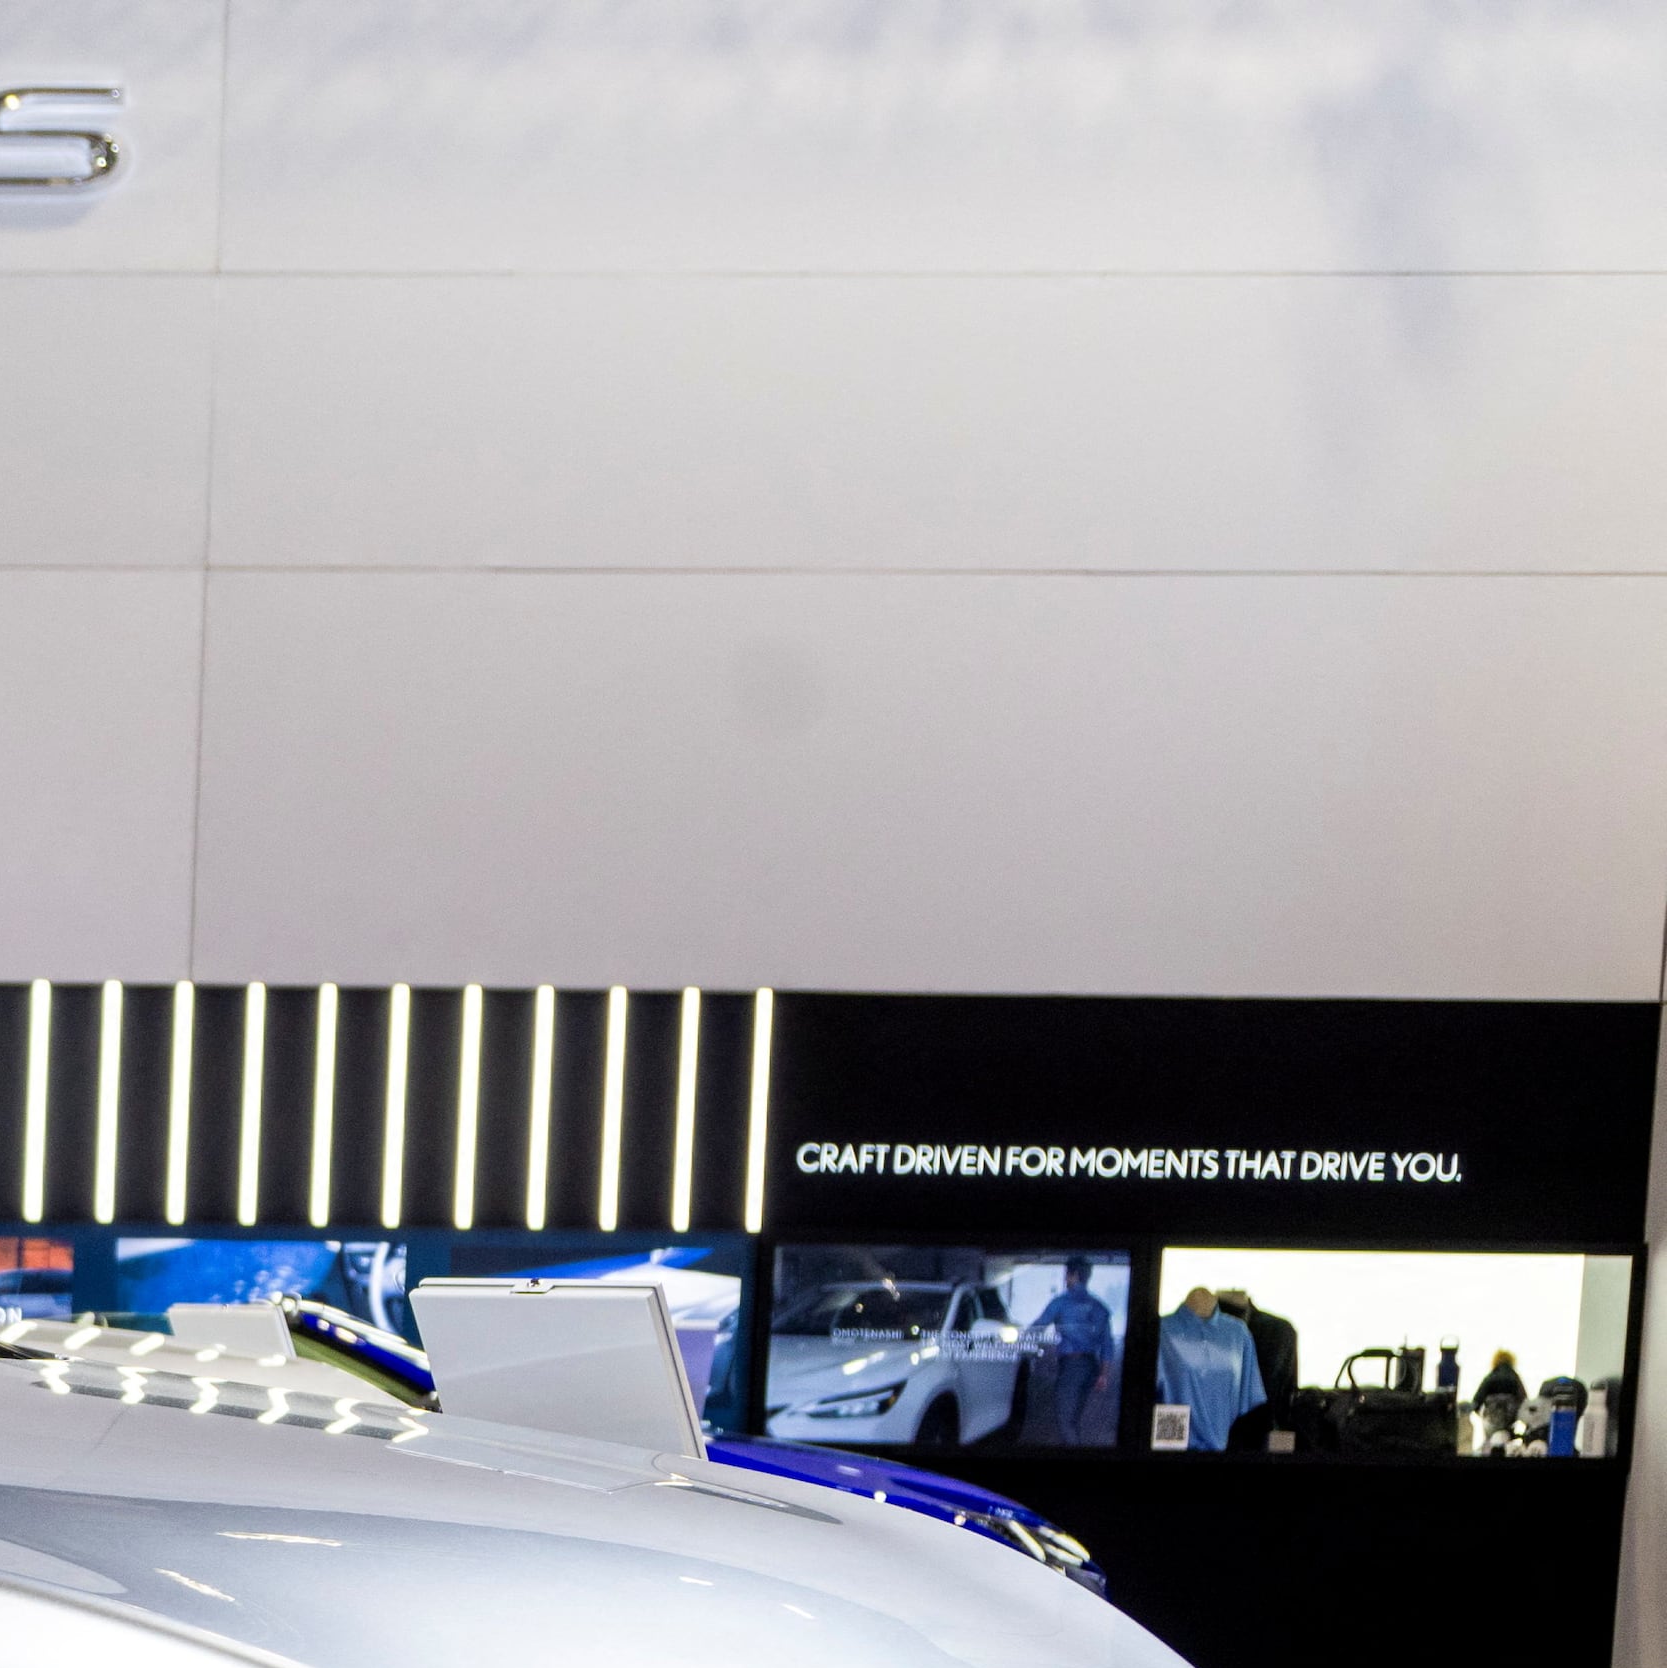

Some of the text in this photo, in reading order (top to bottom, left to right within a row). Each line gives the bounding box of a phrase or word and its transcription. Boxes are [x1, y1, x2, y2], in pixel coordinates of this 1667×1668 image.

[796, 1142, 1461, 1182] CRAFT DRIVEN FOR MOMENTS THAT DRIVE YOU.
